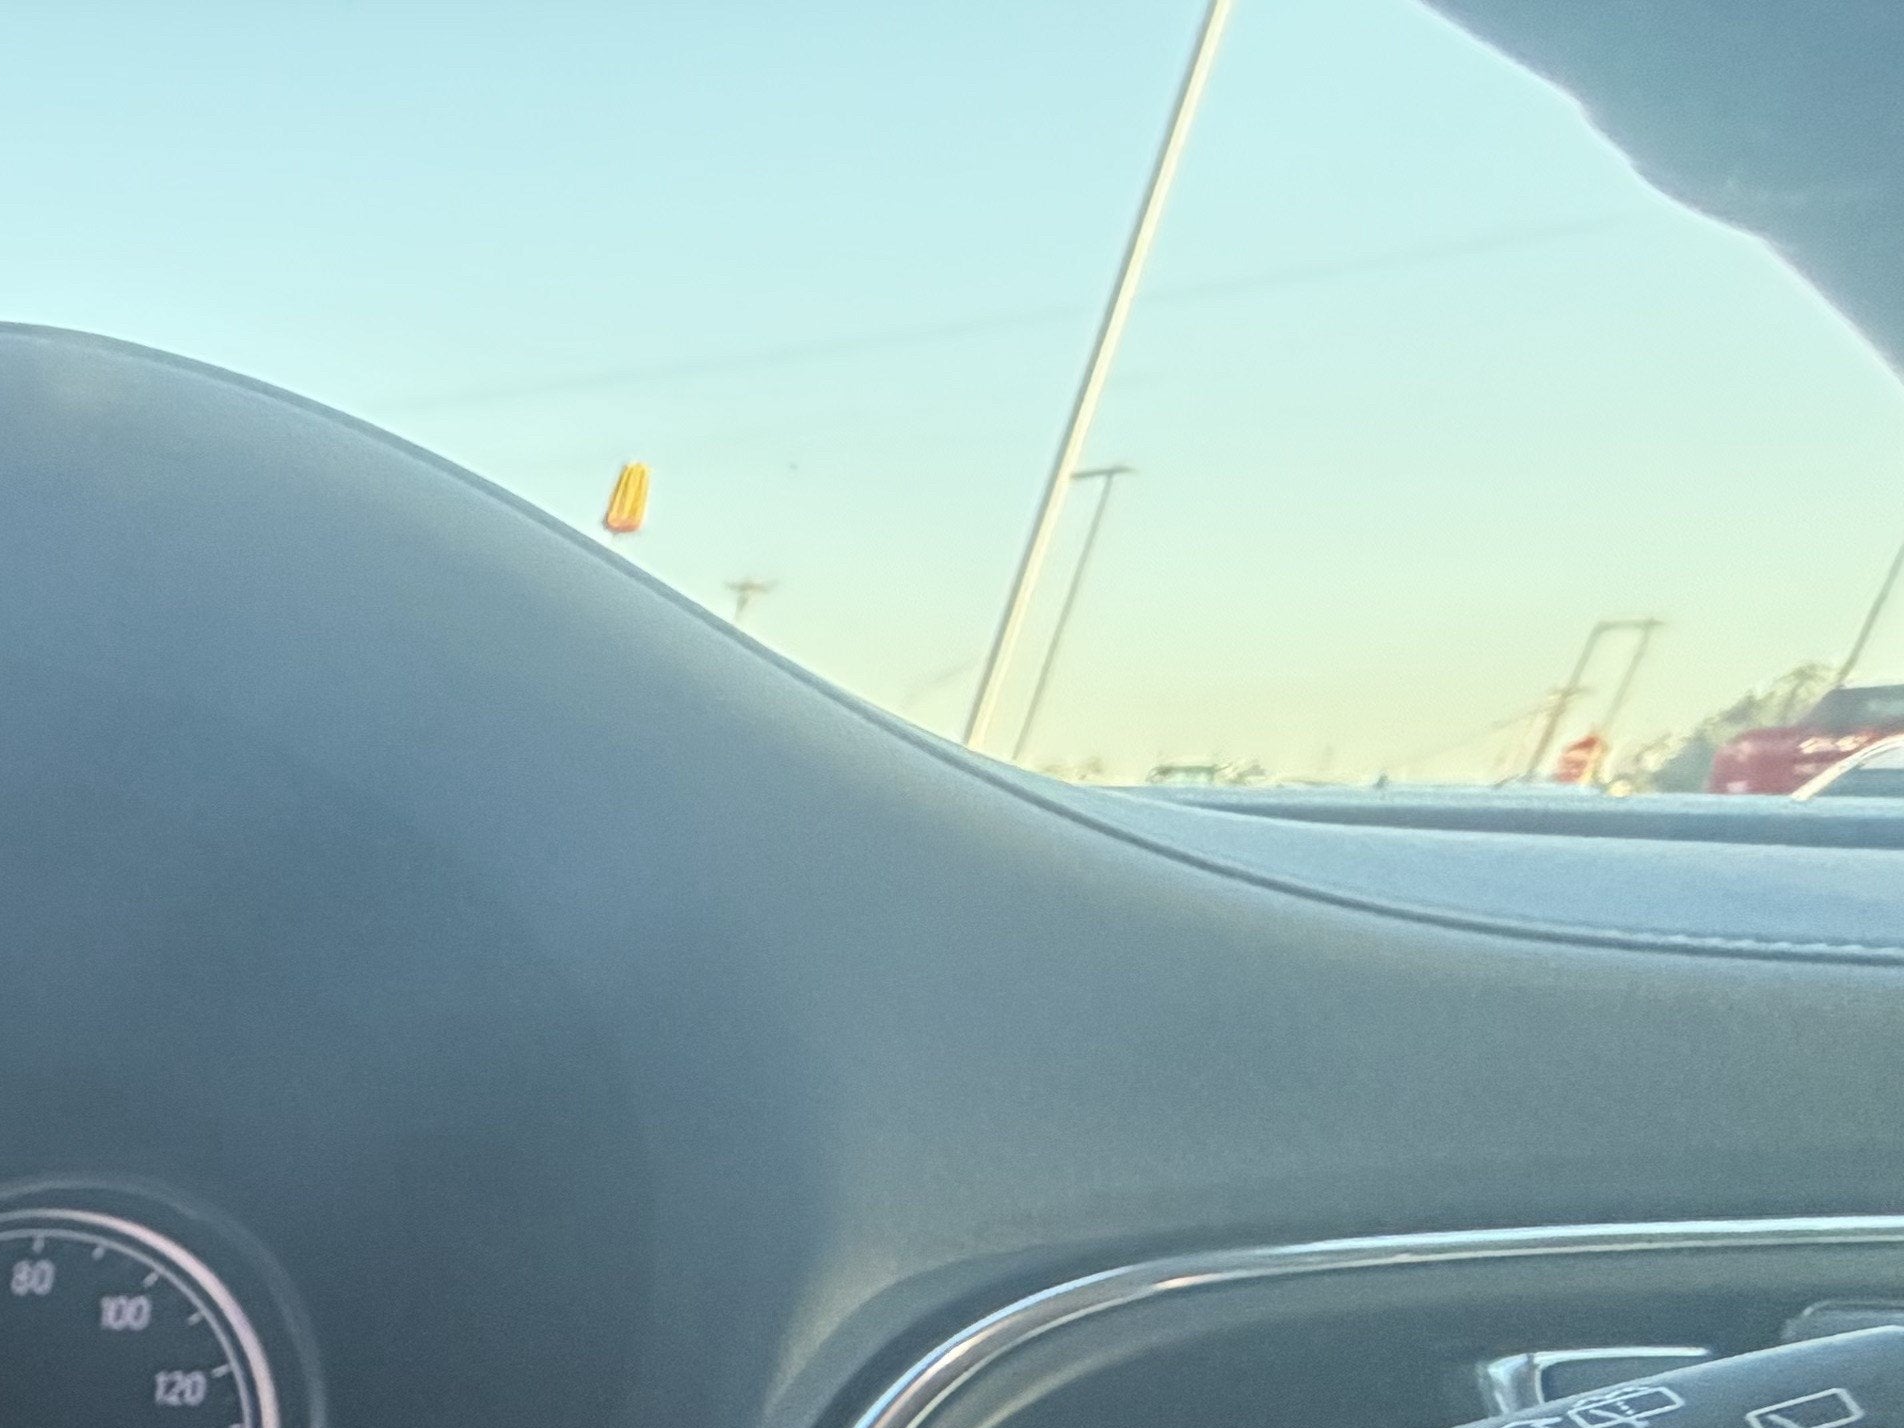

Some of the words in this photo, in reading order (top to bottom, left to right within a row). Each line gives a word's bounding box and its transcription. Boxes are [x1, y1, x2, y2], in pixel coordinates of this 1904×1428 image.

[10, 1259, 55, 1296] 80
[100, 1295, 151, 1330] 100
[154, 1370, 207, 1406] 120
